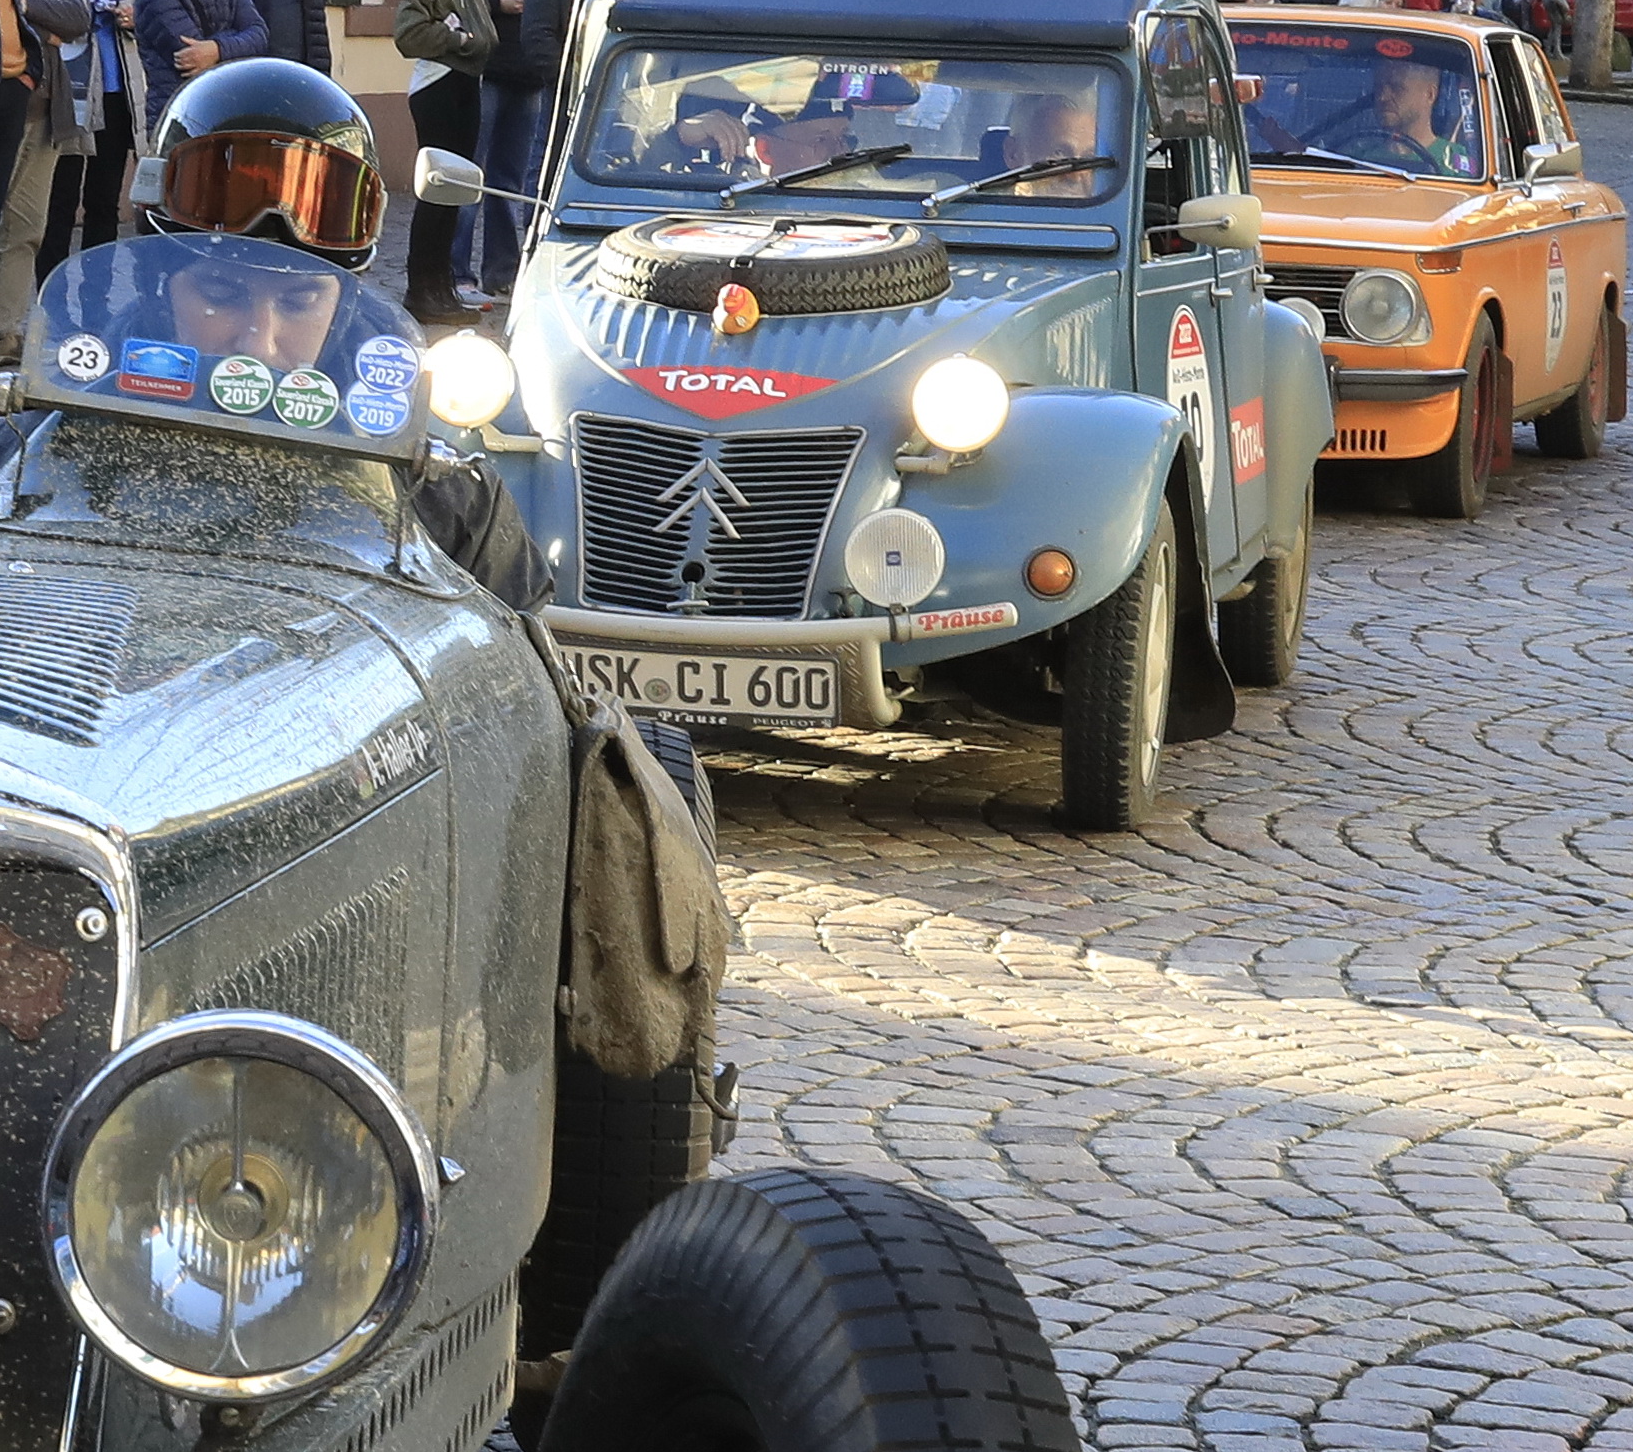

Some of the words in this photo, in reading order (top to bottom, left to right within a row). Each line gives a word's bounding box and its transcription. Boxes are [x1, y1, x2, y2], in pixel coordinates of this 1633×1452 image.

[68, 347, 99, 370] 23
[365, 365, 405, 387] 2022
[658, 369, 787, 398] TOTAL
[221, 386, 261, 406] 2015
[282, 399, 325, 422] 2017
[357, 406, 395, 427] 2019
[1231, 420, 1265, 470] TOTAL
[917, 608, 1005, 633] Prause
[677, 661, 732, 707] CI
[747, 665, 831, 712] 600
[657, 710, 728, 727] Prause
[752, 717, 817, 728] PEUGEOT
